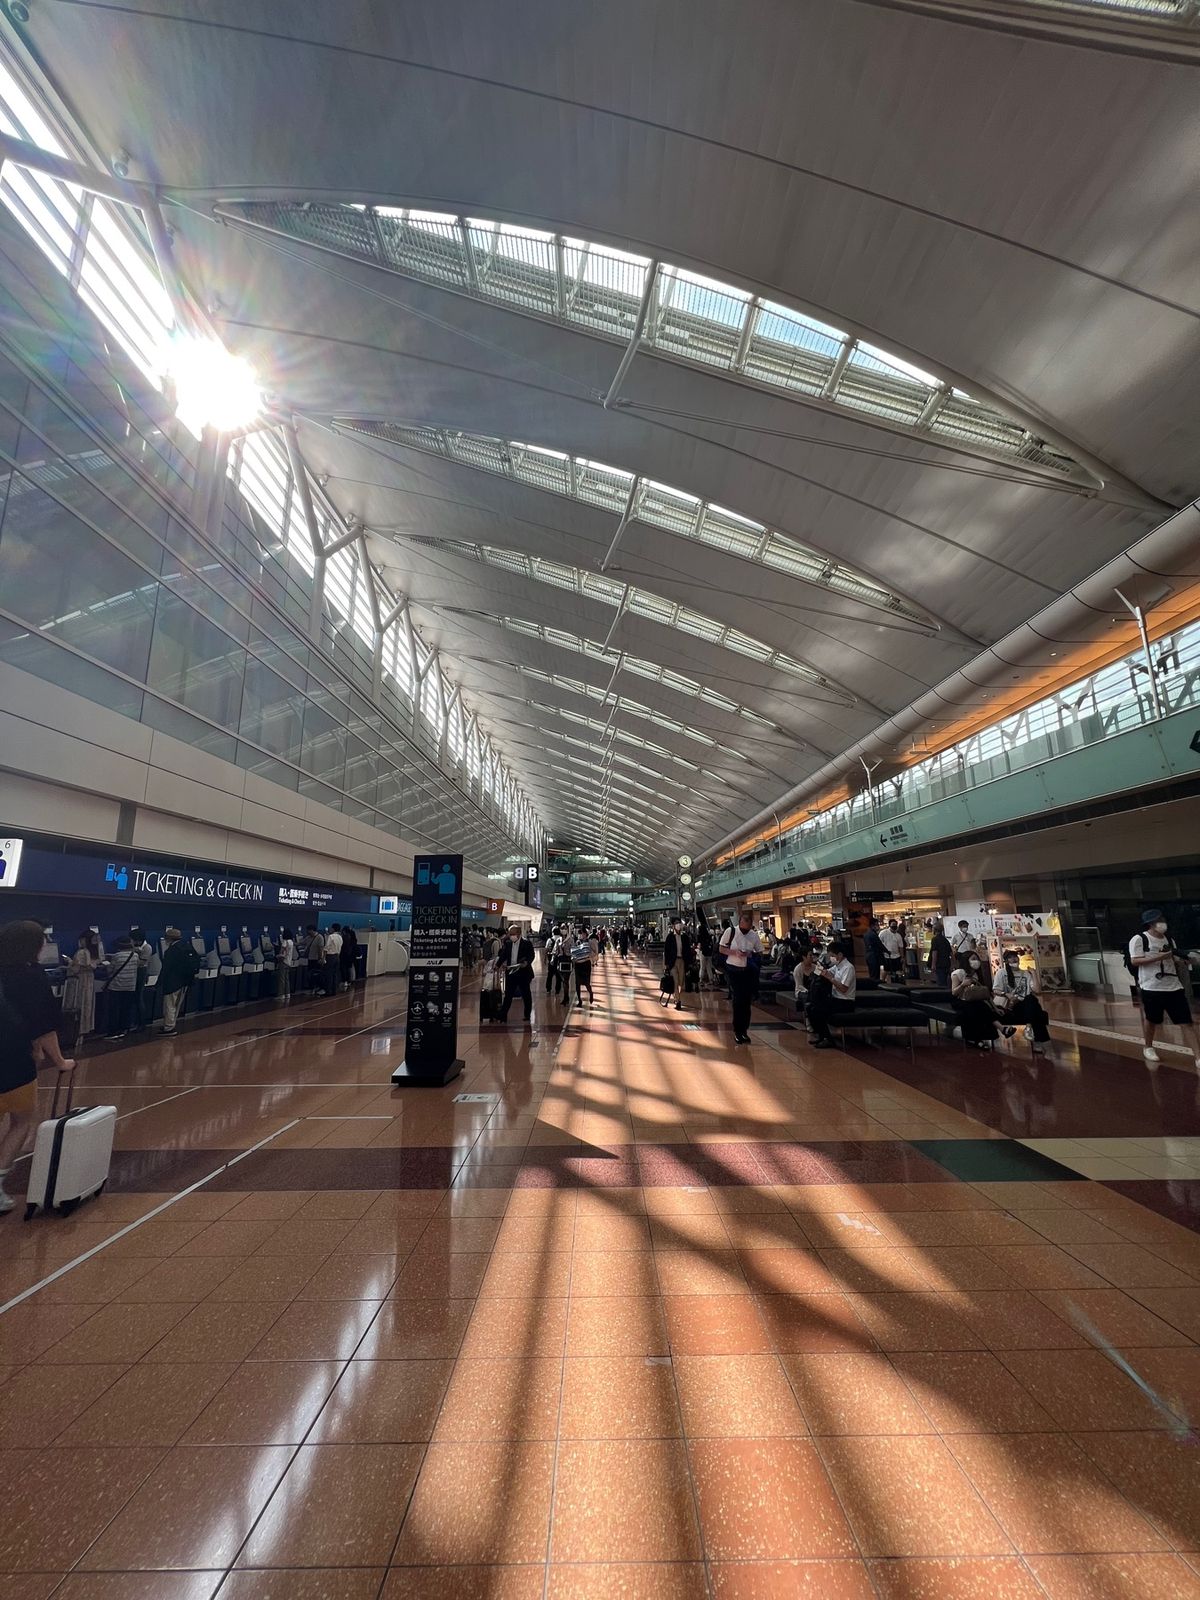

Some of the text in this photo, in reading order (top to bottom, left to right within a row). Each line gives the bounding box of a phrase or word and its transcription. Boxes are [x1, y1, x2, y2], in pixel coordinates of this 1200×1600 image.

[5, 840, 11, 849] 6
[682, 857, 688, 866] 3
[528, 867, 537, 879] B
[133, 870, 263, 901] TICKETING & CHECK IN
[415, 905, 458, 915] TICKETING
[491, 902, 498, 911] B
[418, 915, 447, 925] CHECK
[448, 915, 458, 924] IN
